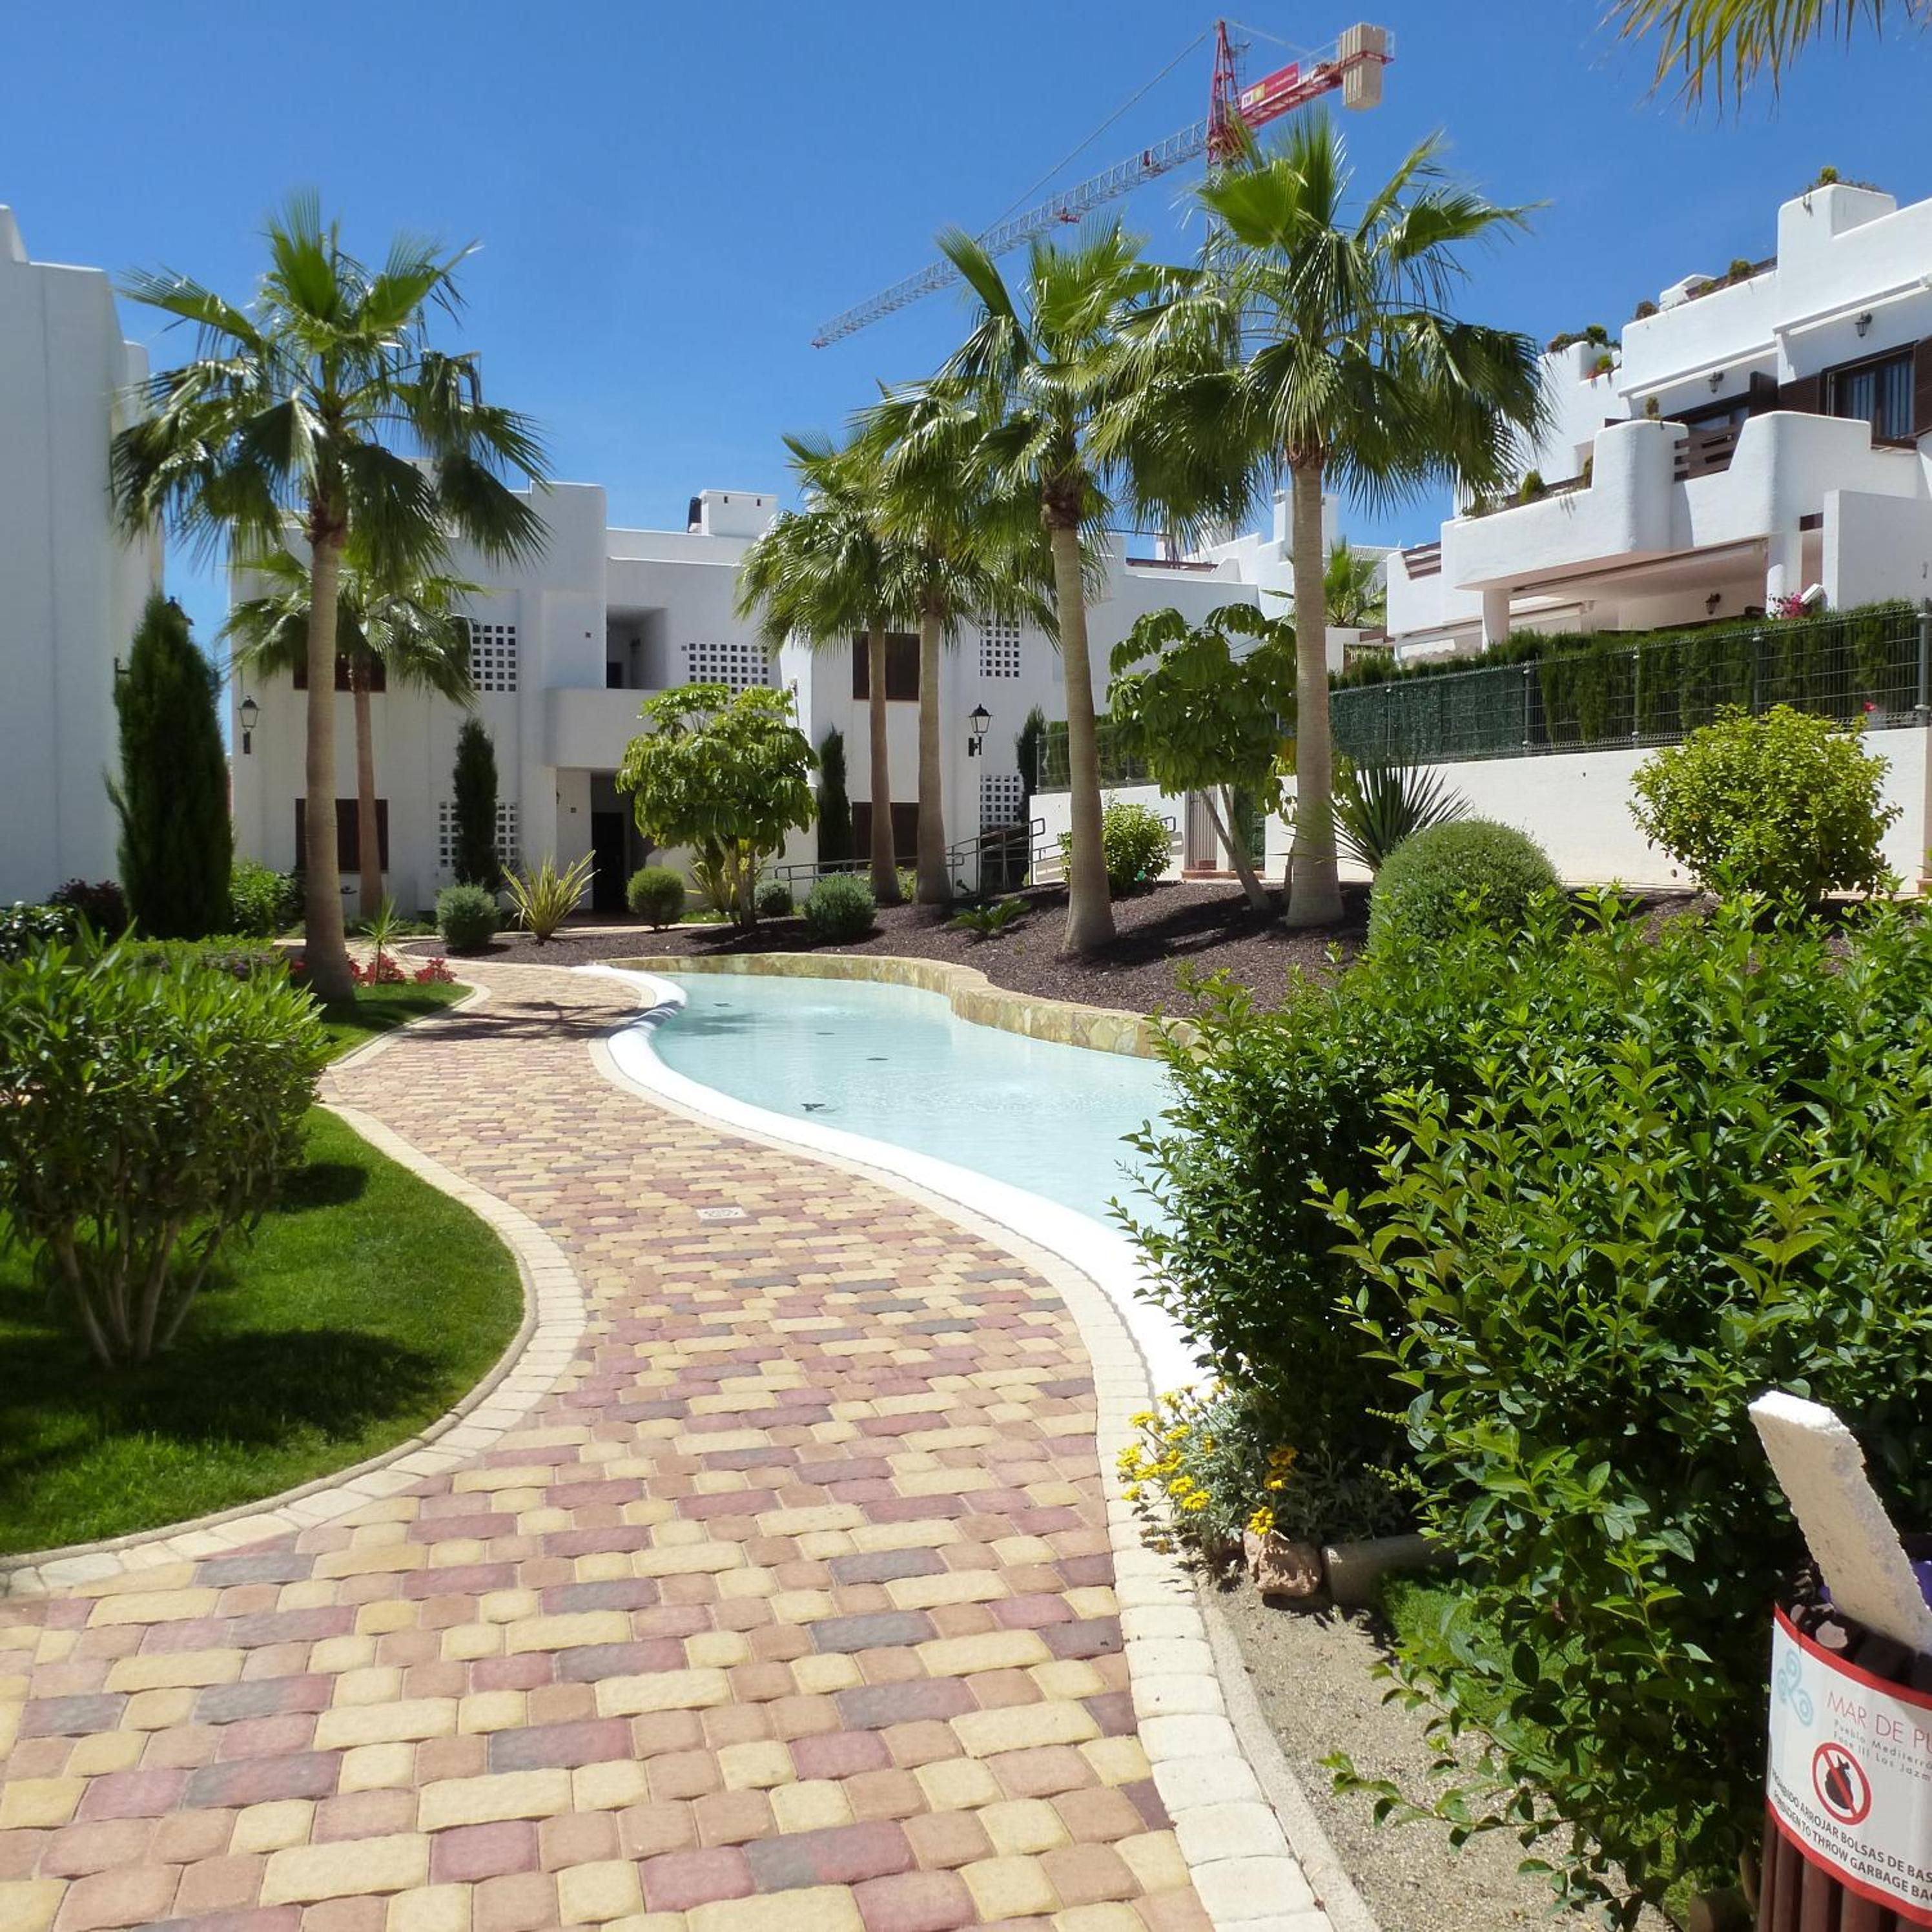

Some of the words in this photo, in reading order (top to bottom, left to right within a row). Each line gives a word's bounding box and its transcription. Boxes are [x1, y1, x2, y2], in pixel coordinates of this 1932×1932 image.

[1827, 1690, 1866, 1729] MAR
[1875, 1713, 1904, 1743] DE
[1875, 1752, 1894, 1767] Los
[1800, 1802, 1839, 1838] ARROJAR
[1840, 1831, 1885, 1864] BOLSAS
[1887, 1855, 1905, 1873] DE
[1801, 1820, 1811, 1836] TO
[1812, 1829, 1849, 1863] THROW
[1850, 1856, 1908, 1893] GARBAGE
[1911, 1884, 1932, 1902] BA
